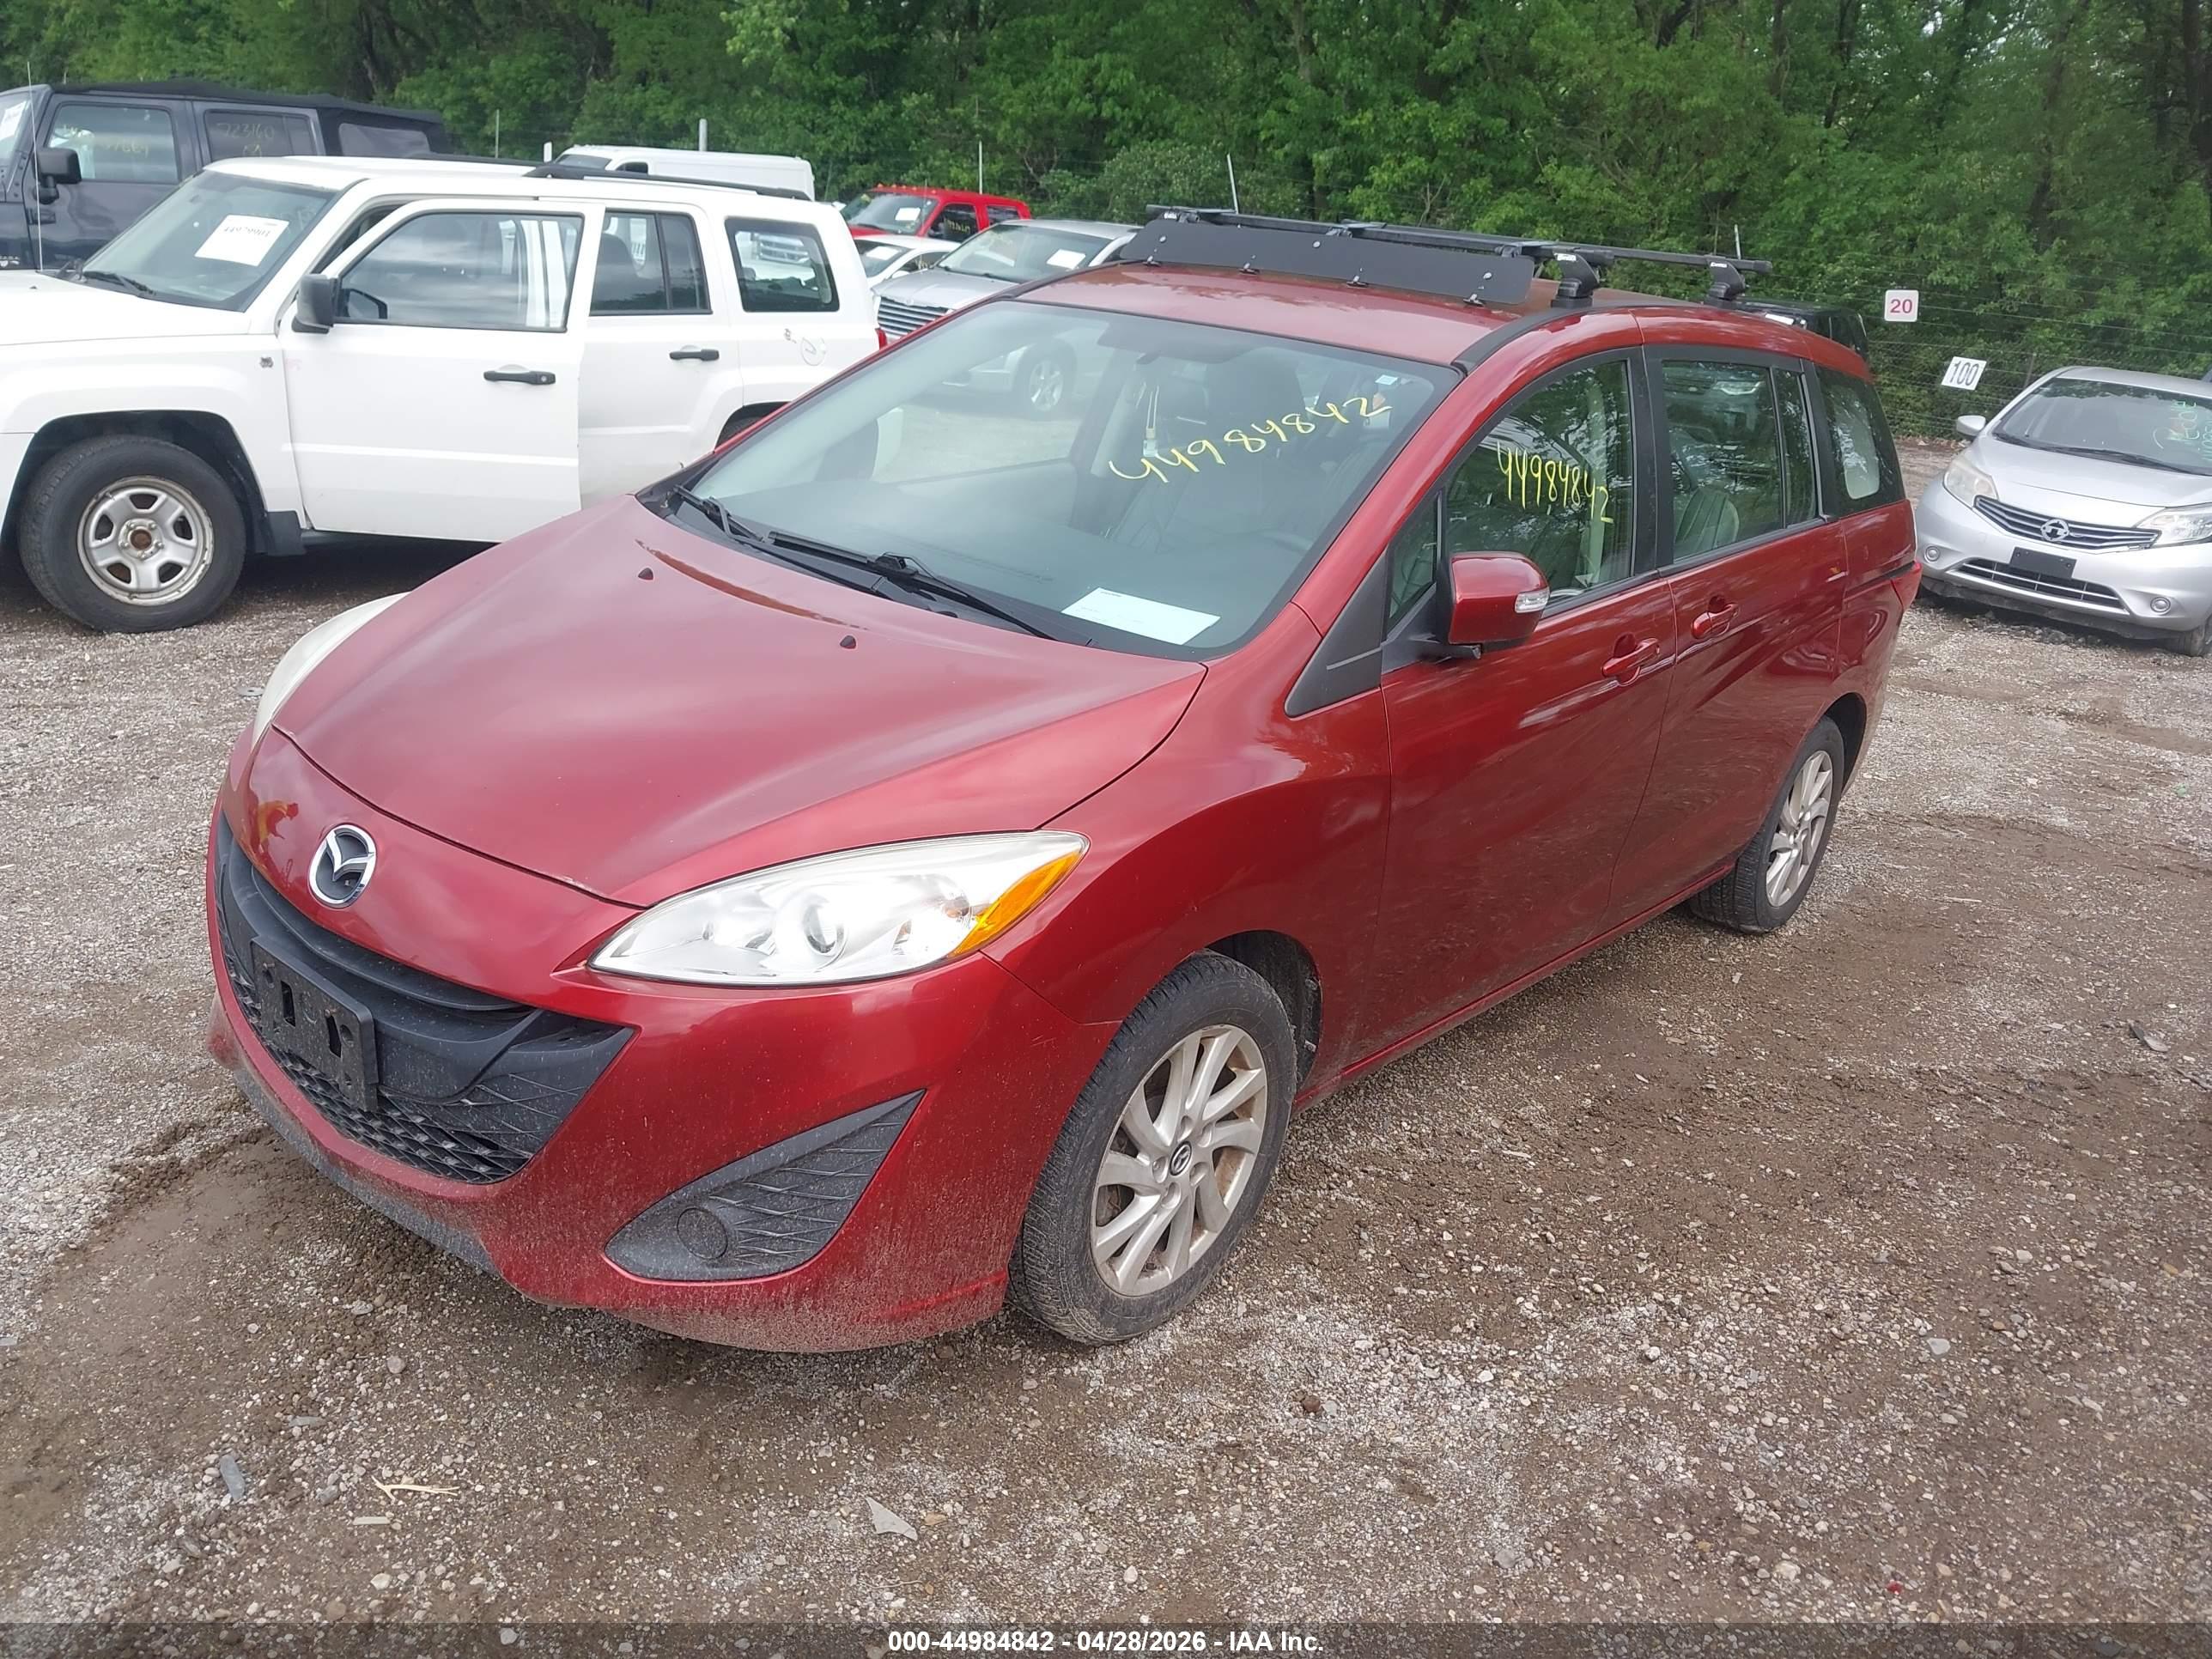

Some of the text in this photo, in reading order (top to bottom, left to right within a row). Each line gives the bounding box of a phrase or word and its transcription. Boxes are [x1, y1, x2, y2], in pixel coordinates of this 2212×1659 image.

[1890, 299, 1913, 314] 20
[1950, 361, 1980, 386] 100
[1108, 396, 1393, 483] 44984842
[1497, 439, 1614, 524] 44984842
